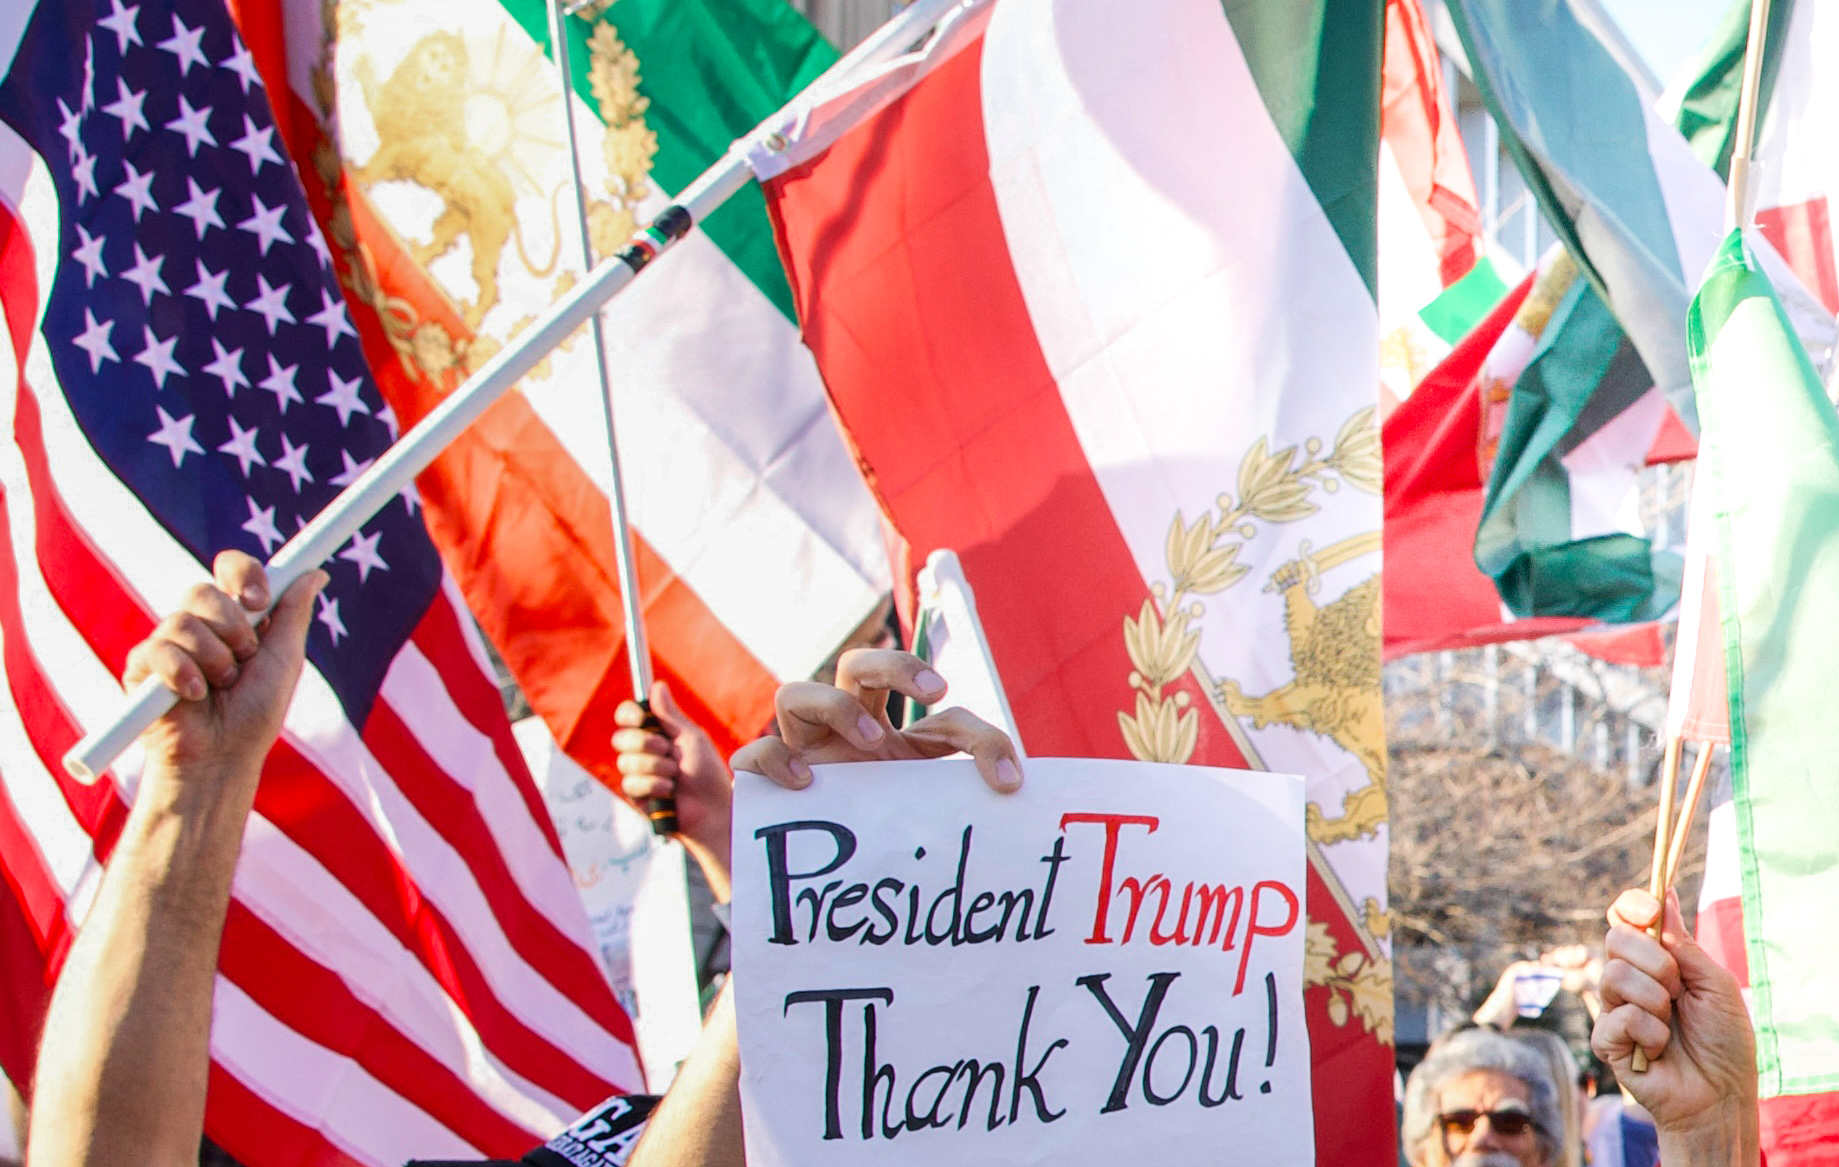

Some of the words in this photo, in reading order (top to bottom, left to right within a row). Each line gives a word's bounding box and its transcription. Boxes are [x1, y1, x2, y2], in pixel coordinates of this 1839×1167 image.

[754, 820, 1070, 947] President
[1058, 812, 1300, 997] Trump
[782, 984, 1069, 1142] Thank
[1074, 971, 1279, 1115] You!
